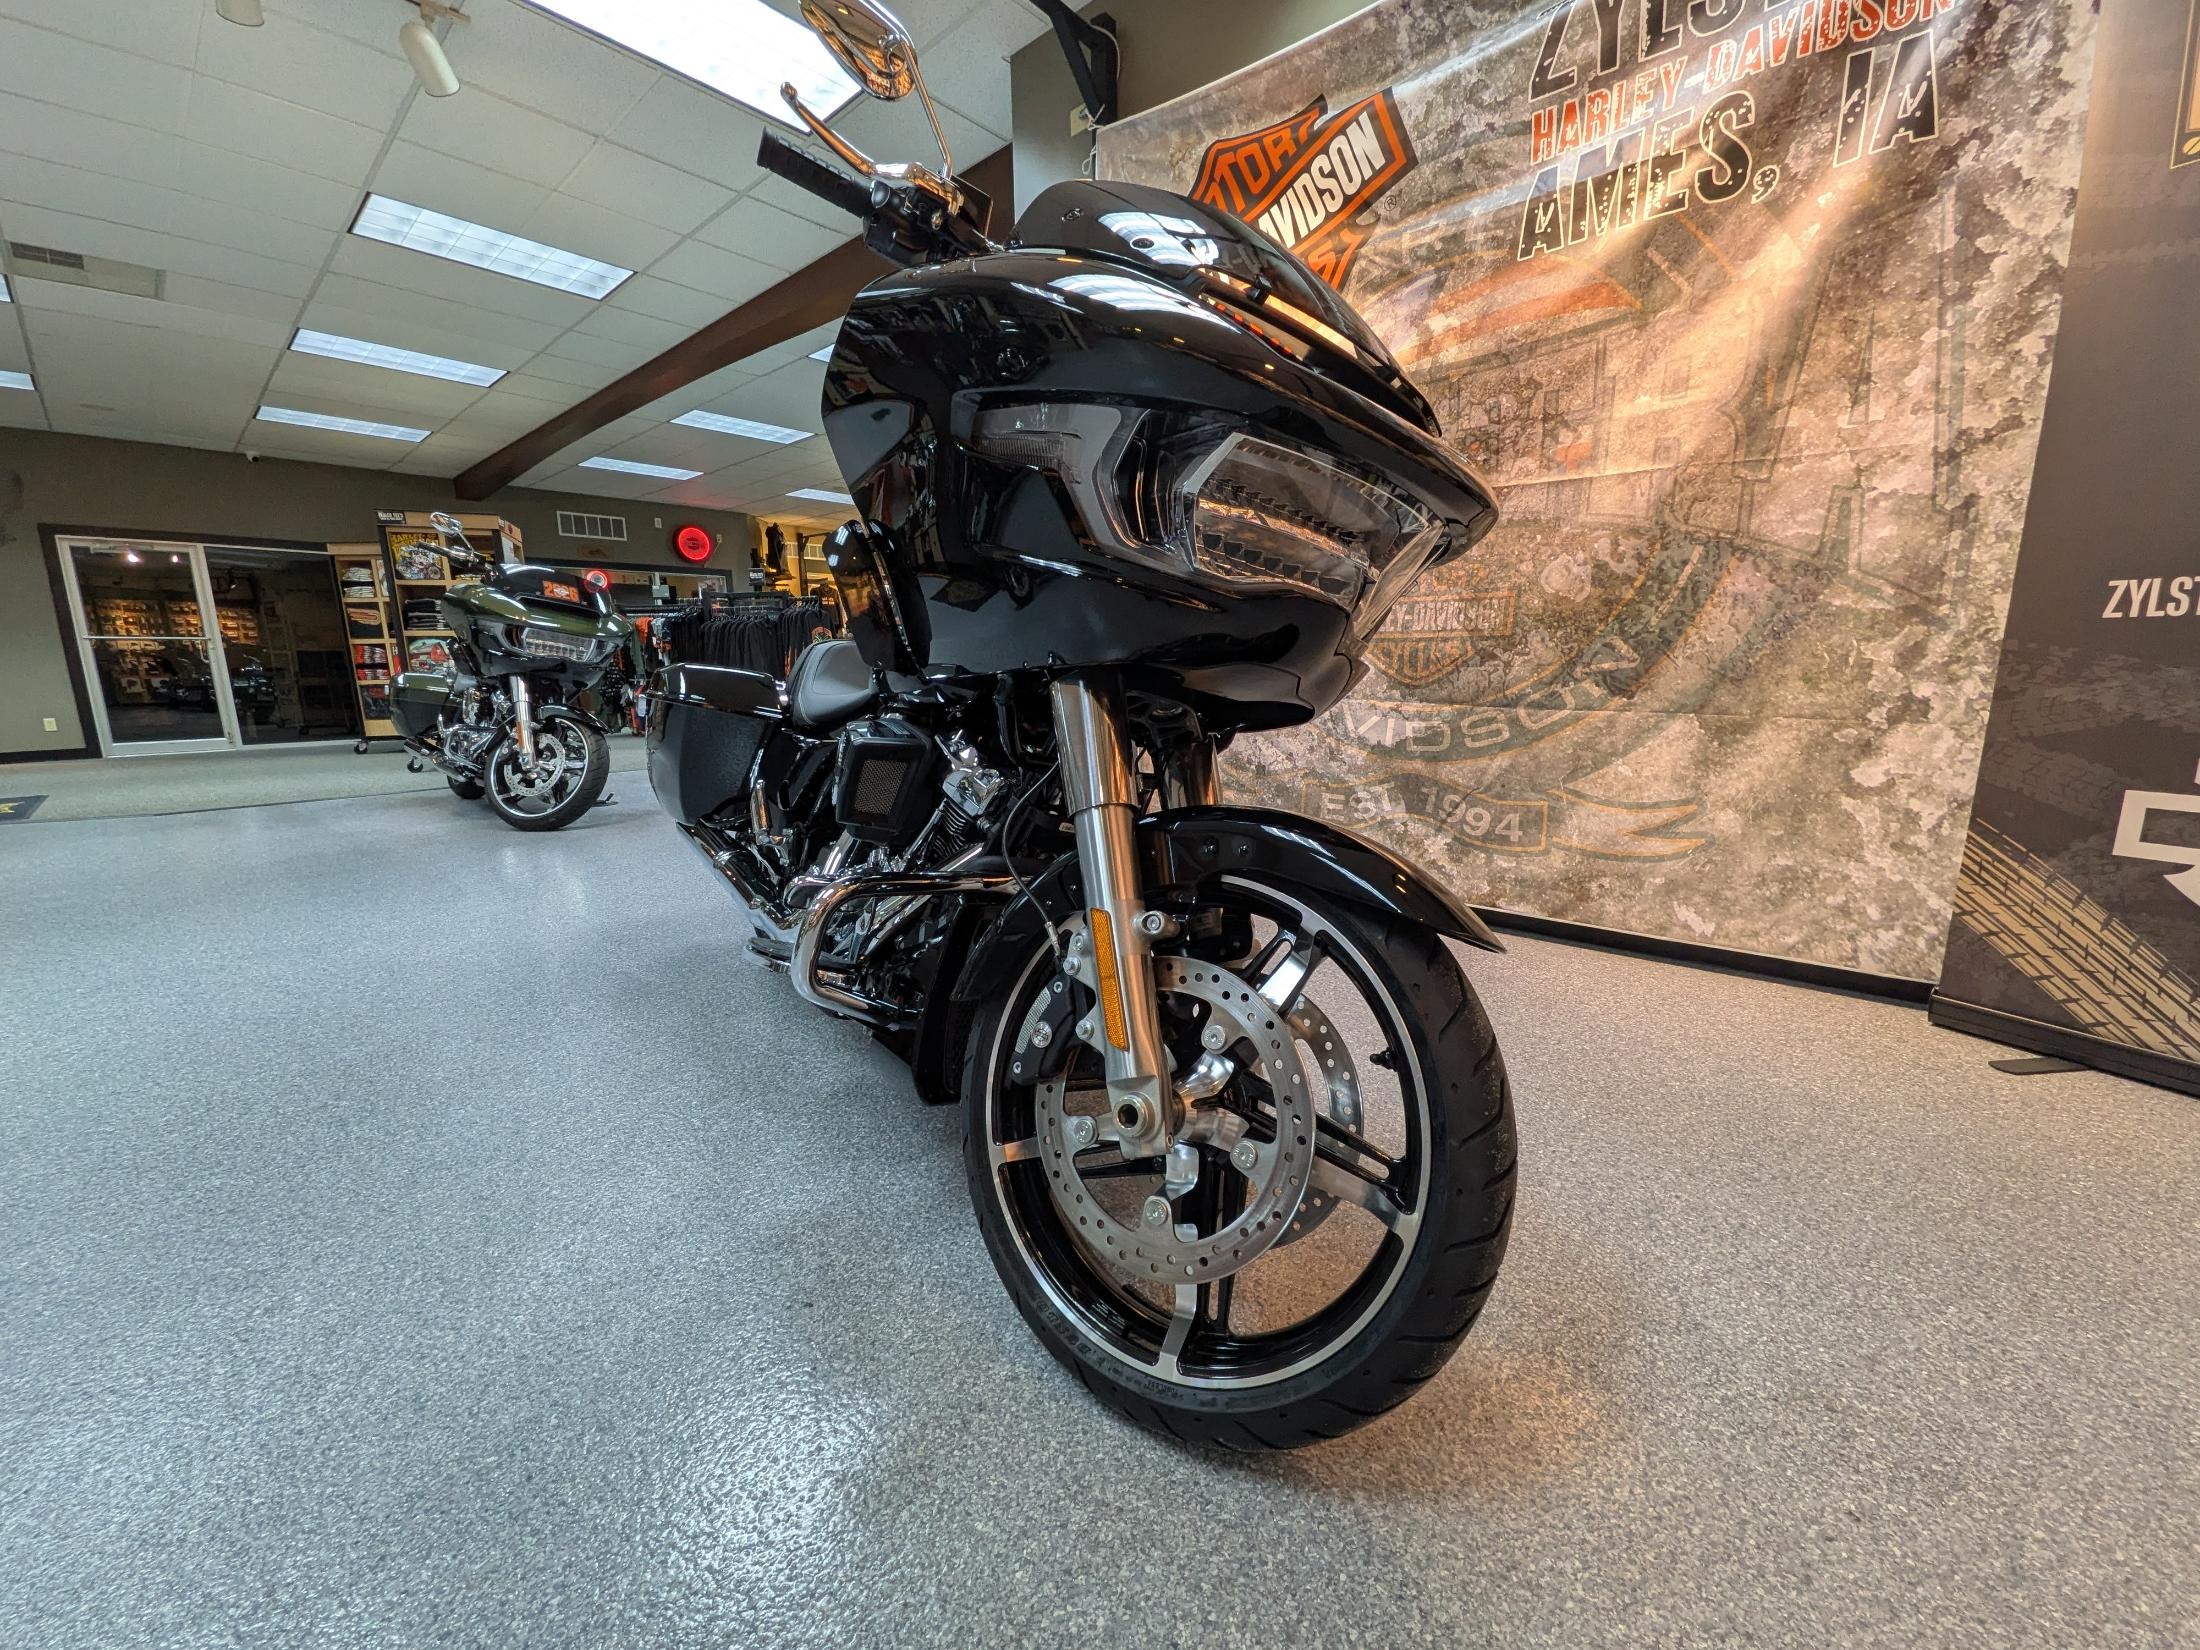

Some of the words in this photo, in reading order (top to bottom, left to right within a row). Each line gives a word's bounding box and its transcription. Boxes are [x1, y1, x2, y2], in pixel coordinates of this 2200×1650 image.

[1257, 111, 1387, 249] AVIDSON
[1517, 90, 1781, 262] AMES,
[1833, 29, 1939, 168] IA
[2101, 575, 2200, 619] ZYLS
[1421, 786, 1524, 842] 1994
